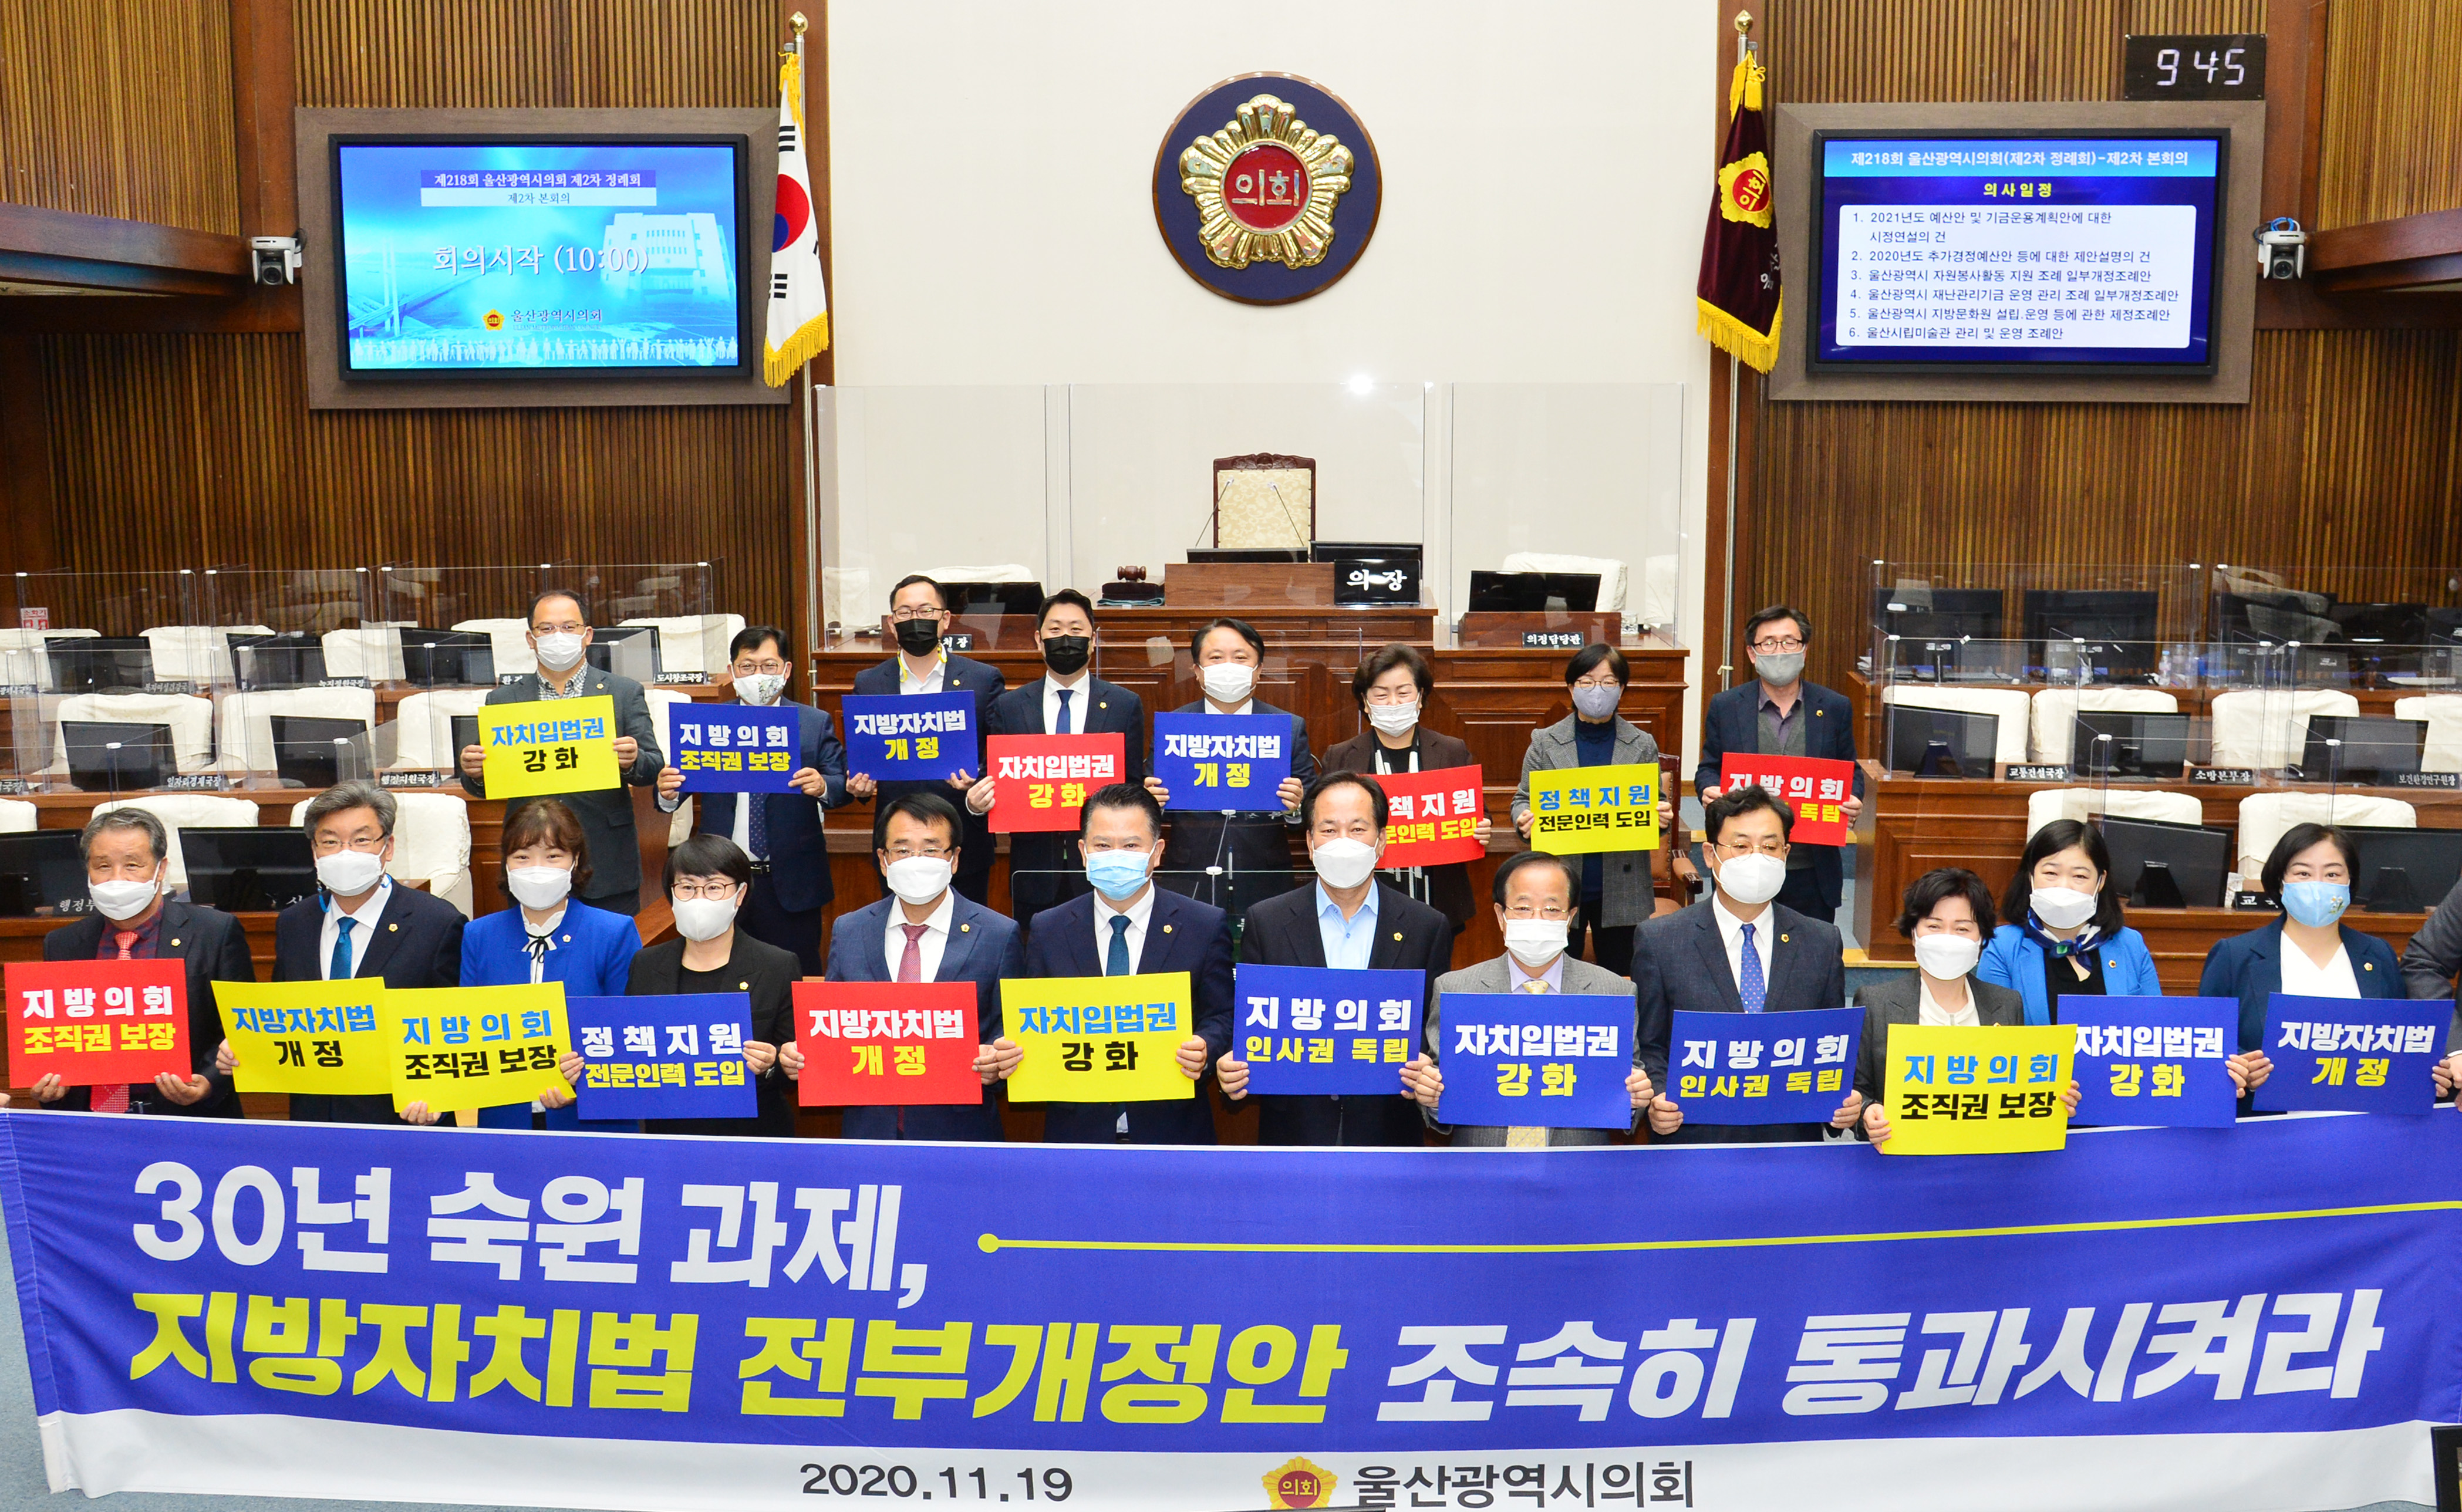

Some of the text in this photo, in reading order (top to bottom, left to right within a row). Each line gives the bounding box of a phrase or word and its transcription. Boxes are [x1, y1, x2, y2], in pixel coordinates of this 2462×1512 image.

[1851, 151, 1903, 166] 제218회
[2147, 151, 2188, 166] 본회의
[434, 173, 641, 187] 제218회 울산광역시의회 제2차 정례회
[1232, 169, 1299, 207] 의회
[1739, 170, 1766, 211] 의회
[508, 193, 569, 204] 제2차 본회의
[1853, 212, 2112, 224] 1. 2021년도 예산안 및 기금운용계획안에 대한
[1870, 231, 1945, 243] 시정연설의 건
[433, 245, 649, 275] 회의시작 (10:00)
[1851, 251, 2150, 263] 2. 2020년도 추가경정예산안 등에 대한 제안설명의 건
[1851, 270, 2151, 282] 3. 울산광역시 자원봉사활동 지원 조례 일부개정조례안
[1850, 289, 2178, 302] 4. 울산광역시 재난관리기금 운영 관리 조례 일부개정조례안
[511, 309, 602, 323] 울산광역시의회
[1850, 308, 1860, 318] 5.
[1868, 308, 1927, 320] 울산광역시
[1932, 308, 1991, 320] 지방문화원
[2053, 309, 2077, 320] 등에
[2082, 309, 2105, 320] 관한
[2110, 309, 2170, 321] 제정조례안
[1849, 328, 2063, 339] 6. 울산시립미술관 관리 및 운영 조례안
[1526, 634, 1580, 646] 의정담당관
[491, 717, 605, 747] 자치입법권
[854, 709, 967, 735] 지방자치법
[680, 750, 792, 772] 조직권 보장
[1164, 734, 1281, 759] 지방자치법
[998, 754, 1115, 779] 자치입법권
[1389, 788, 1476, 819] 책지원
[1800, 802, 1841, 823] 독립
[1385, 817, 1478, 845] 문인력 도입
[1539, 808, 1651, 833] 전문인력 도입
[231, 1004, 377, 1034] 지방자치법
[809, 1009, 964, 1039] 지방자치법
[1018, 1001, 1178, 1035] 자치입법권
[24, 1022, 176, 1054] 조직권 보장
[1243, 1035, 1411, 1067] 인사권 독립
[1455, 1024, 1619, 1057] 자치입법권
[2074, 1024, 2224, 1059] 자치입법권
[2277, 1021, 2436, 1054] 지방자치법
[404, 1044, 557, 1080] 조직권 보장
[582, 1057, 744, 1089] 전문인력 도입
[1679, 1068, 1844, 1098] 인사권 독립
[1900, 1091, 2057, 1120] 조직권 보장
[133, 1161, 928, 1310] 30년 숙원 과제,
[126, 1288, 2386, 1425] 지방자치법 전부개정안 조속히 통과시켜라
[800, 1463, 1073, 1502] 2020.11.19
[1280, 1479, 1317, 1496] 의회
[1348, 1460, 1694, 1511] 울산광역시의회
